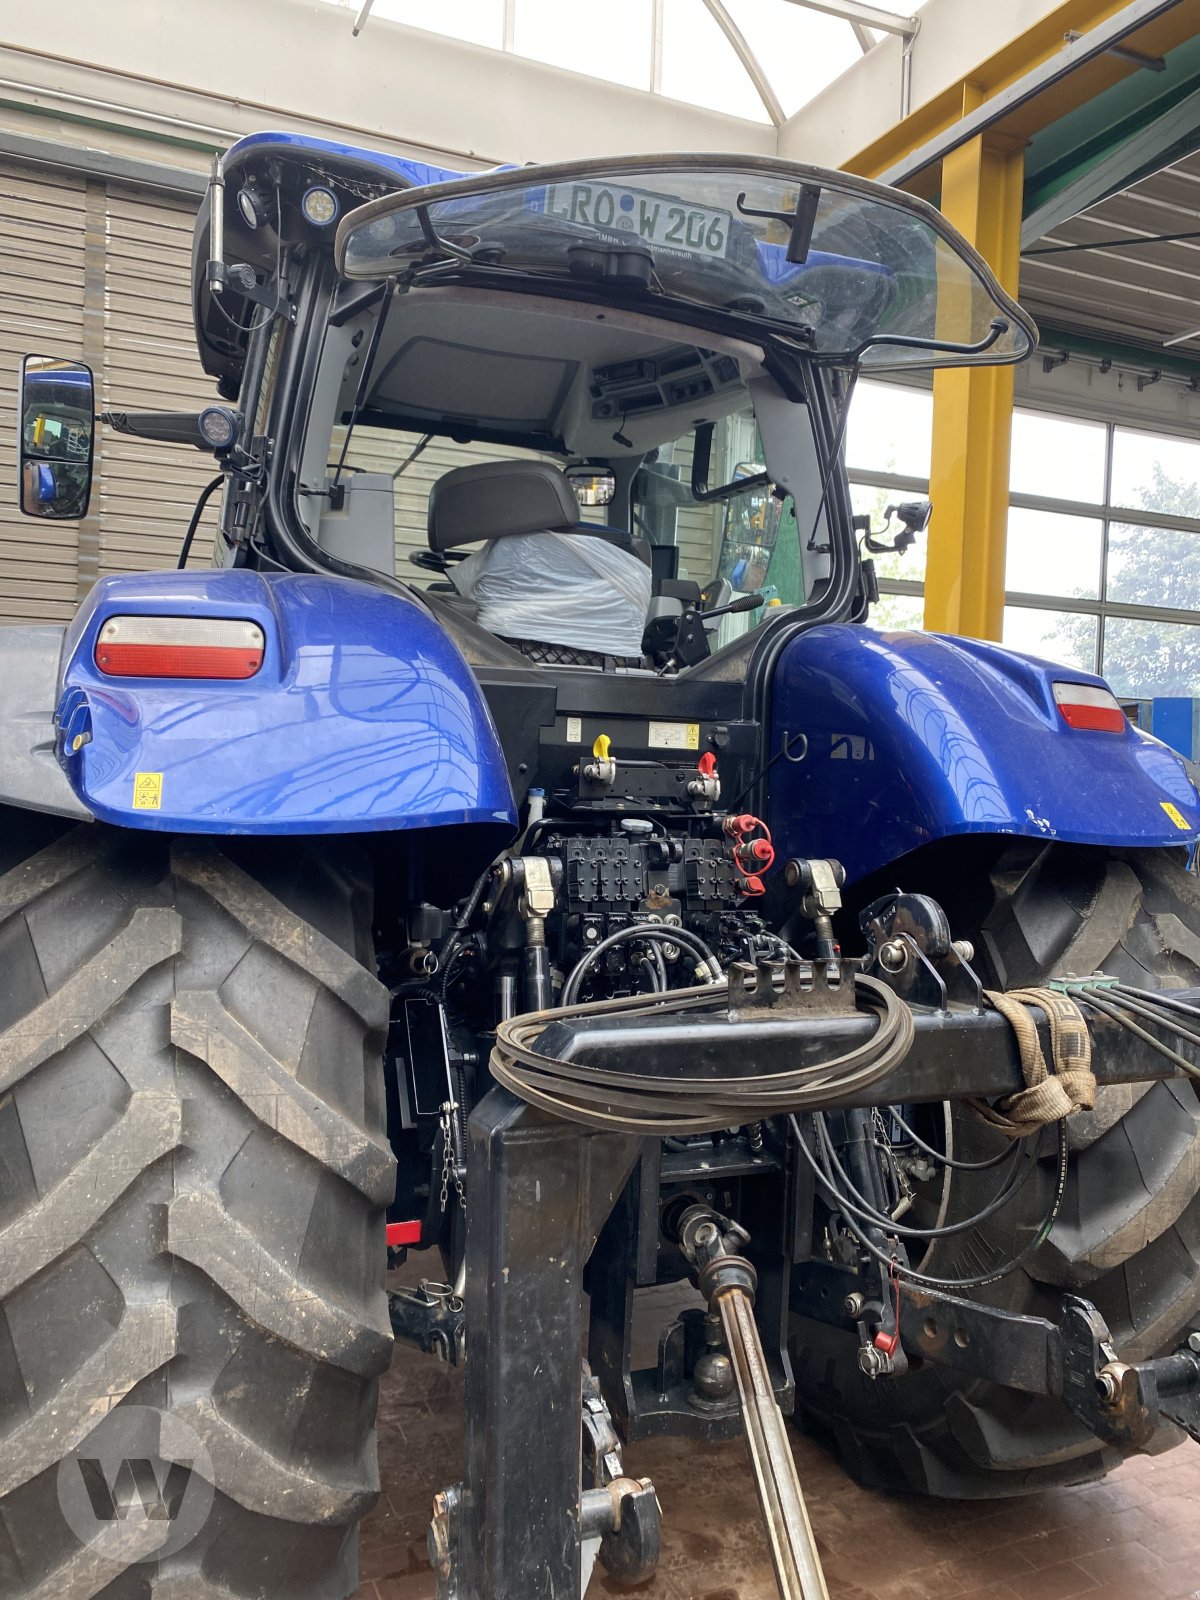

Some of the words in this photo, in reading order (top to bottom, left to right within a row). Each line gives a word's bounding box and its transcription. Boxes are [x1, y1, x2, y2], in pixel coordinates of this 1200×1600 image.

[547, 184, 614, 226] LRO
[640, 200, 660, 238] W
[665, 207, 723, 251] 206
